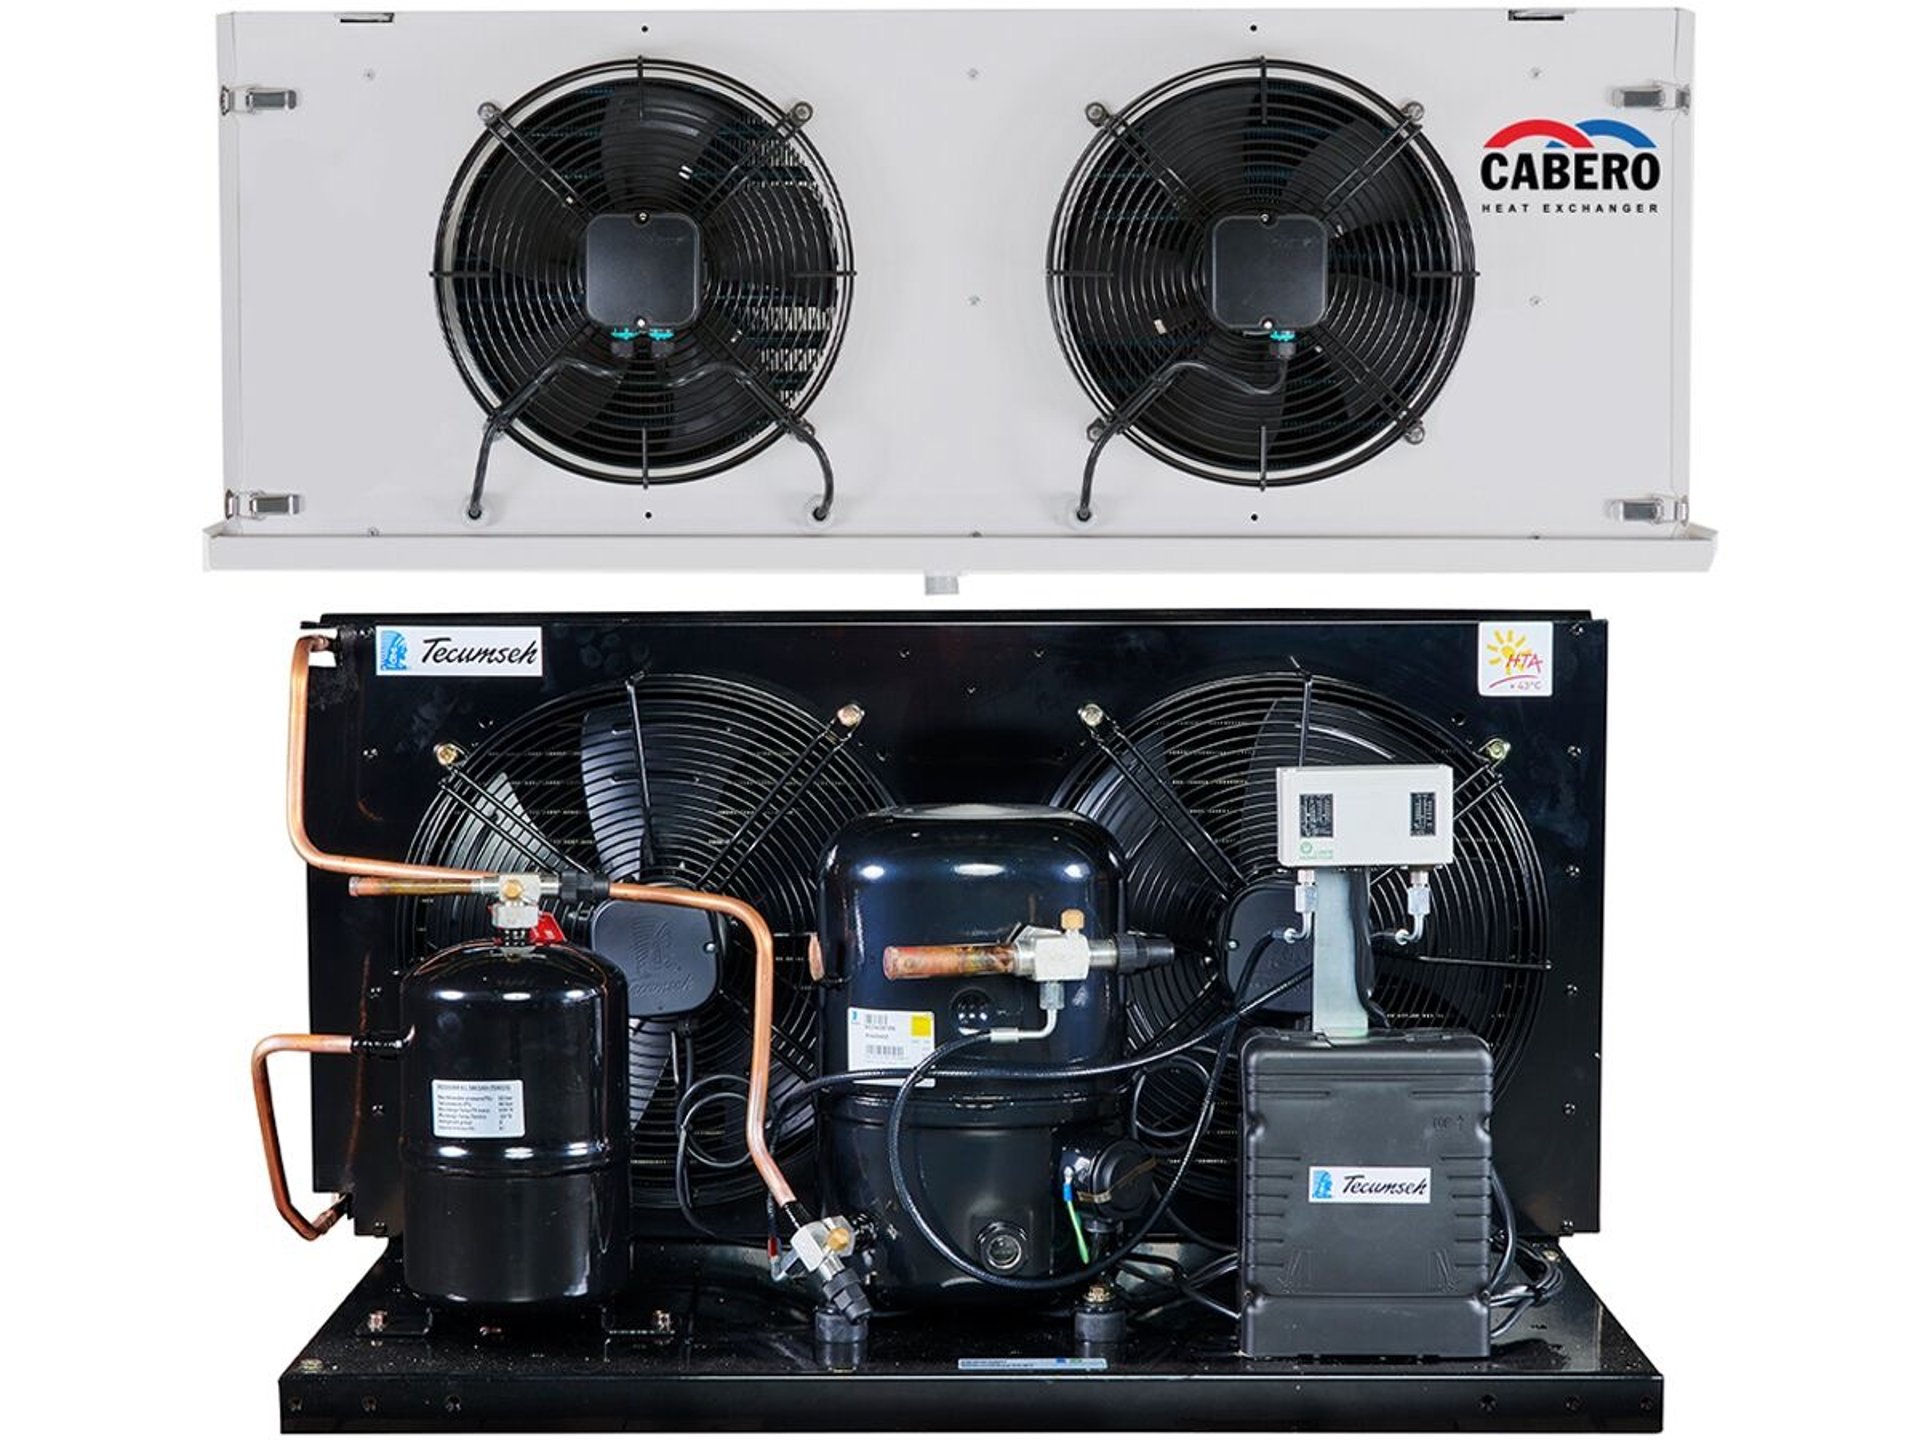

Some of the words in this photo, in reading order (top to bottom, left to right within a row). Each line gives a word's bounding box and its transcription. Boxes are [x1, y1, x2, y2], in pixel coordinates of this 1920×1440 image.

[1480, 152, 1661, 191] CABERO
[1481, 203, 1529, 213] HEAT
[1543, 203, 1659, 213] EXCHANGER
[421, 637, 538, 665] Tecumseh
[1342, 1174, 1427, 1195] Tecumseh
